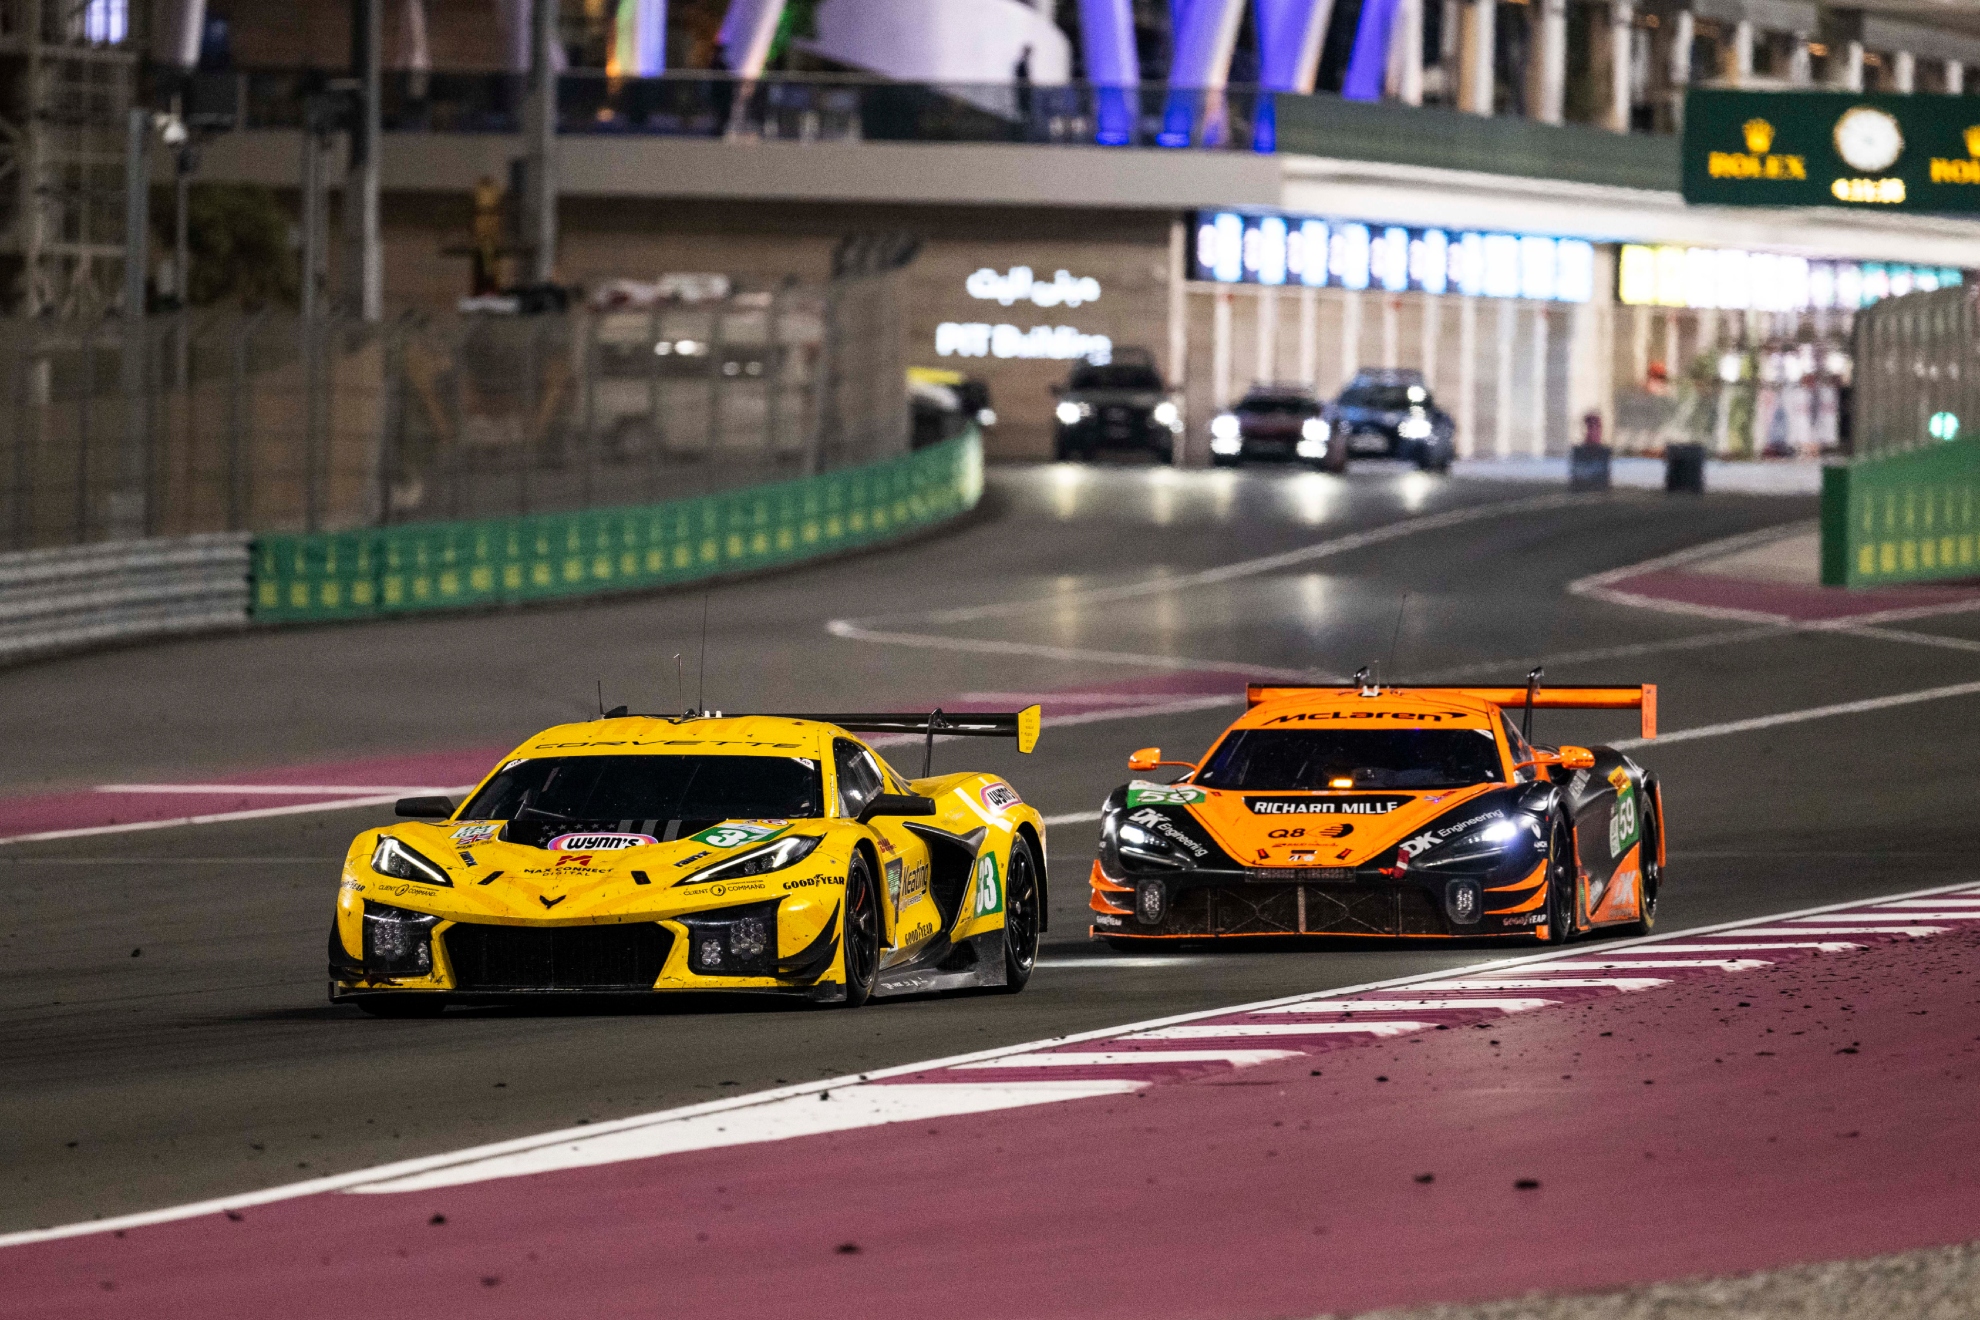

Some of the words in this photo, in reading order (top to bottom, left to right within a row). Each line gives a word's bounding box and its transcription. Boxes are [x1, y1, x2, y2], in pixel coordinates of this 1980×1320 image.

[1260, 711, 1443, 727] McLaren
[535, 740, 802, 749] CORVETTE
[1136, 790, 1198, 803] 59
[1128, 807, 1172, 829] DK
[1619, 796, 1636, 841] 59
[1157, 822, 1209, 858] Engineering
[1267, 828, 1306, 839] Q8
[1399, 831, 1444, 858] DK
[1437, 808, 1505, 838] Engineering
[555, 866, 615, 874] CONNECT
[902, 860, 929, 897] Keating
[683, 888, 709, 896] CLIENT
[727, 883, 766, 892] COMMAND
[783, 874, 845, 890] GOODYEAR
[975, 856, 998, 914] 33
[904, 922, 934, 946] GOODYEAR
